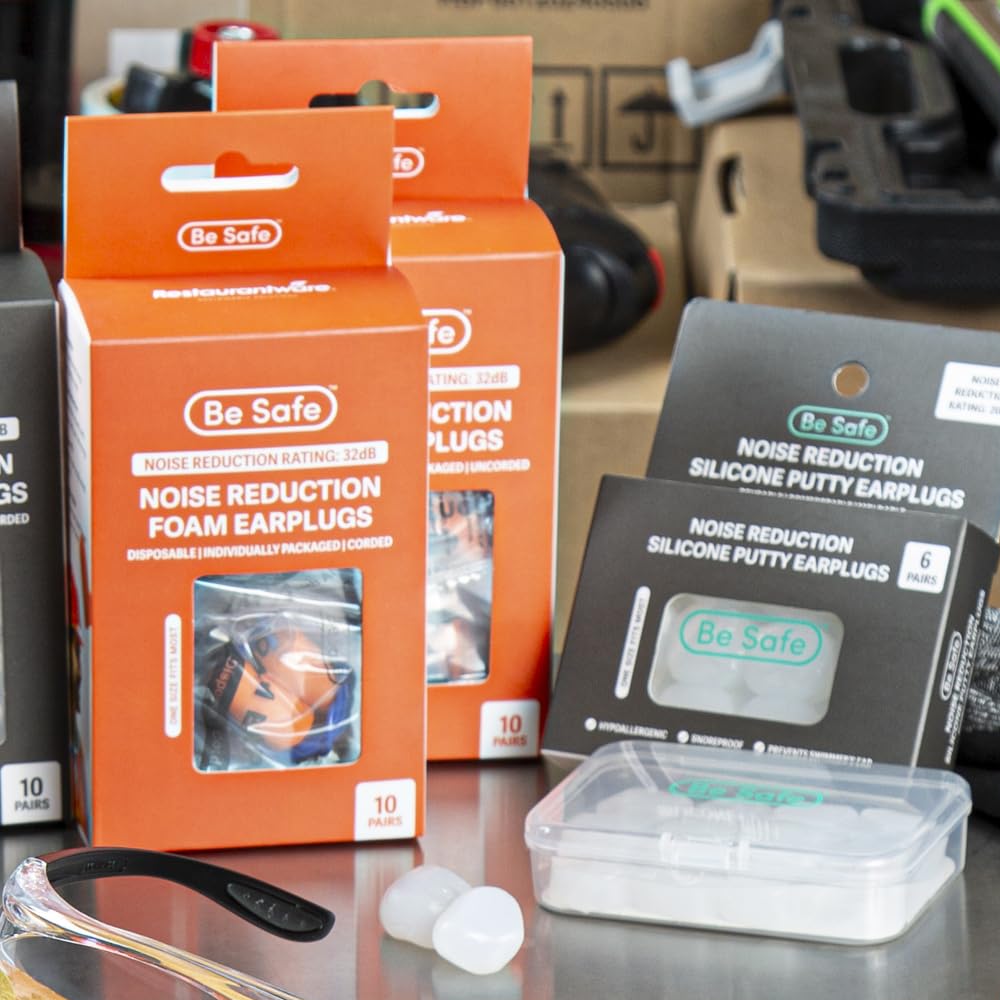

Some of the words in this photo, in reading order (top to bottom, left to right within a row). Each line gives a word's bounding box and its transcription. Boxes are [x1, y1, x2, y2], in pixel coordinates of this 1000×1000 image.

[393, 153, 414, 172] fe
[190, 227, 218, 246] Be
[223, 225, 271, 245] Safe
[428, 318, 456, 345] fe
[971, 375, 1000, 386] NOISE
[203, 399, 243, 427] Be
[252, 395, 321, 424] Safe
[430, 400, 513, 424] CTION
[800, 411, 826, 433] Be
[831, 415, 877, 439] Safe
[429, 428, 504, 453] LUGS
[144, 456, 189, 472] NOISE
[193, 453, 278, 470] REDUCTION
[282, 450, 339, 466] RATING:
[343, 447, 377, 462] 32dB
[429, 461, 464, 475] KAGED
[737, 437, 801, 463] NOISE
[803, 445, 925, 478] REDUCTION
[139, 484, 221, 509] NOISE
[227, 476, 382, 507] REDUCTION
[688, 456, 786, 487] SILICONE
[786, 469, 856, 496] PUTTY
[855, 478, 966, 510] EARPLUGS
[149, 512, 228, 538] FOAM
[234, 506, 373, 536] EARPLUGS
[127, 548, 197, 561] DISPOSABLE
[204, 543, 280, 559] INDIVIDUALLY
[281, 539, 341, 555] PACKAGED
[347, 535, 393, 550] CORDED
[689, 517, 746, 541] NOISE
[747, 524, 855, 555] REDUCTION
[647, 535, 731, 563] SILICONE
[733, 545, 794, 570] PUTTY
[792, 554, 891, 583] EARPLUGS
[919, 551, 933, 569] 6
[906, 572, 938, 586] PAIRS
[696, 619, 733, 647] Be
[742, 624, 807, 656] Safe
[500, 714, 522, 734] 10
[493, 734, 528, 748] PAIRS
[20, 776, 43, 797] 10
[15, 798, 50, 812] PAIRS
[374, 794, 397, 815] 10
[368, 815, 403, 829] PAIRS
